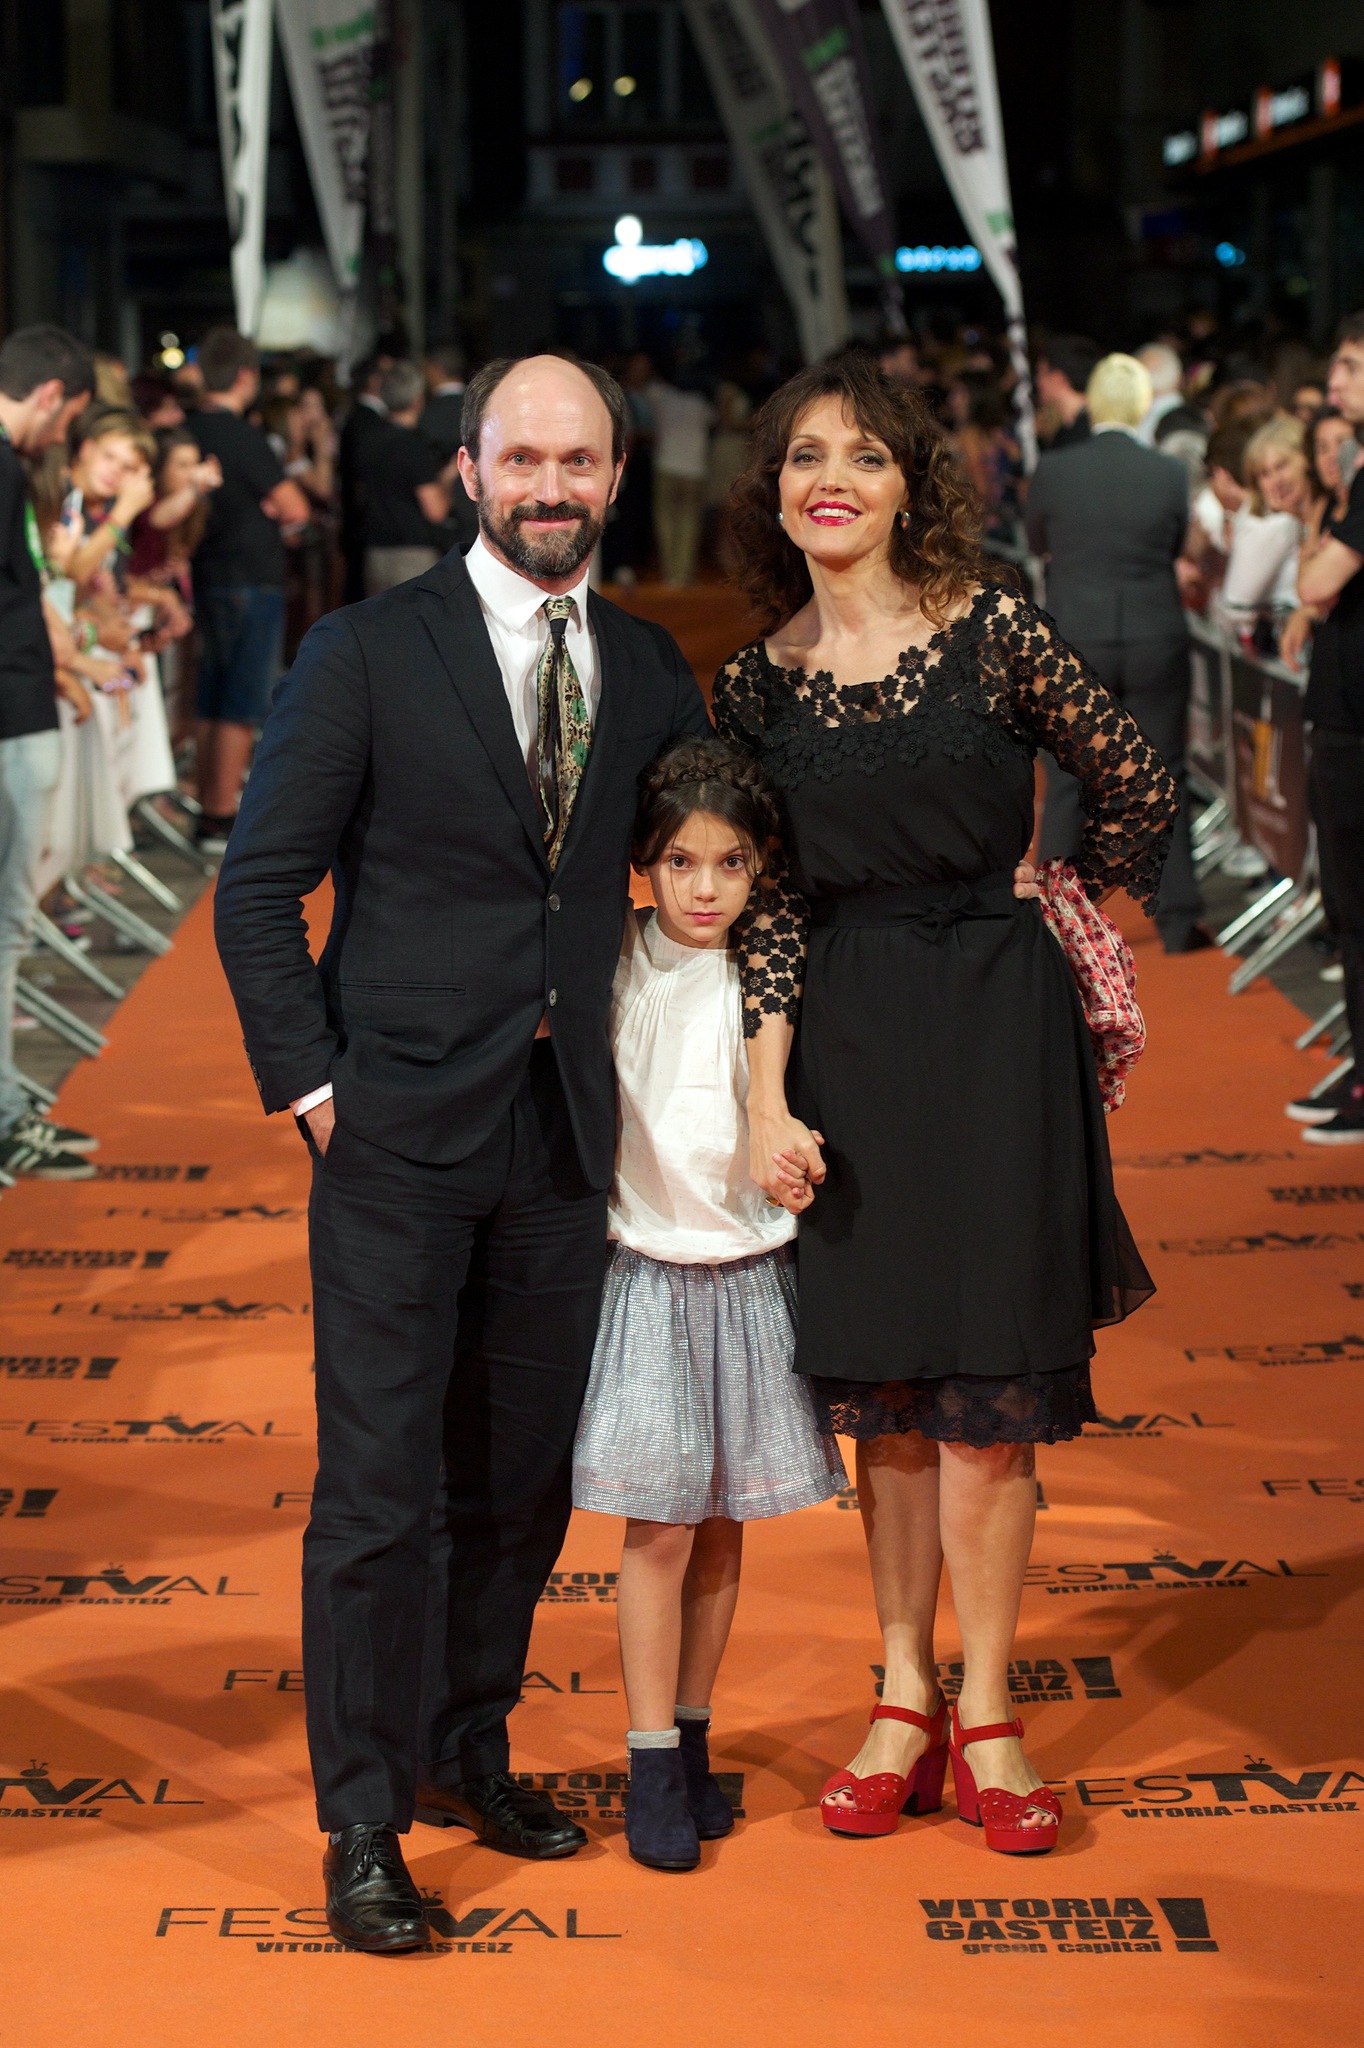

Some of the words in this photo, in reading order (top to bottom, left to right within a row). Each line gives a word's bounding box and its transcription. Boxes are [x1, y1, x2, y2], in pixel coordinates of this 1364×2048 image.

[918, 1897, 1154, 1919] VITORIA
[925, 1918, 1160, 1941] GASTEIZ
[962, 1940, 1049, 1955] green
[1057, 1939, 1163, 1955] capital
